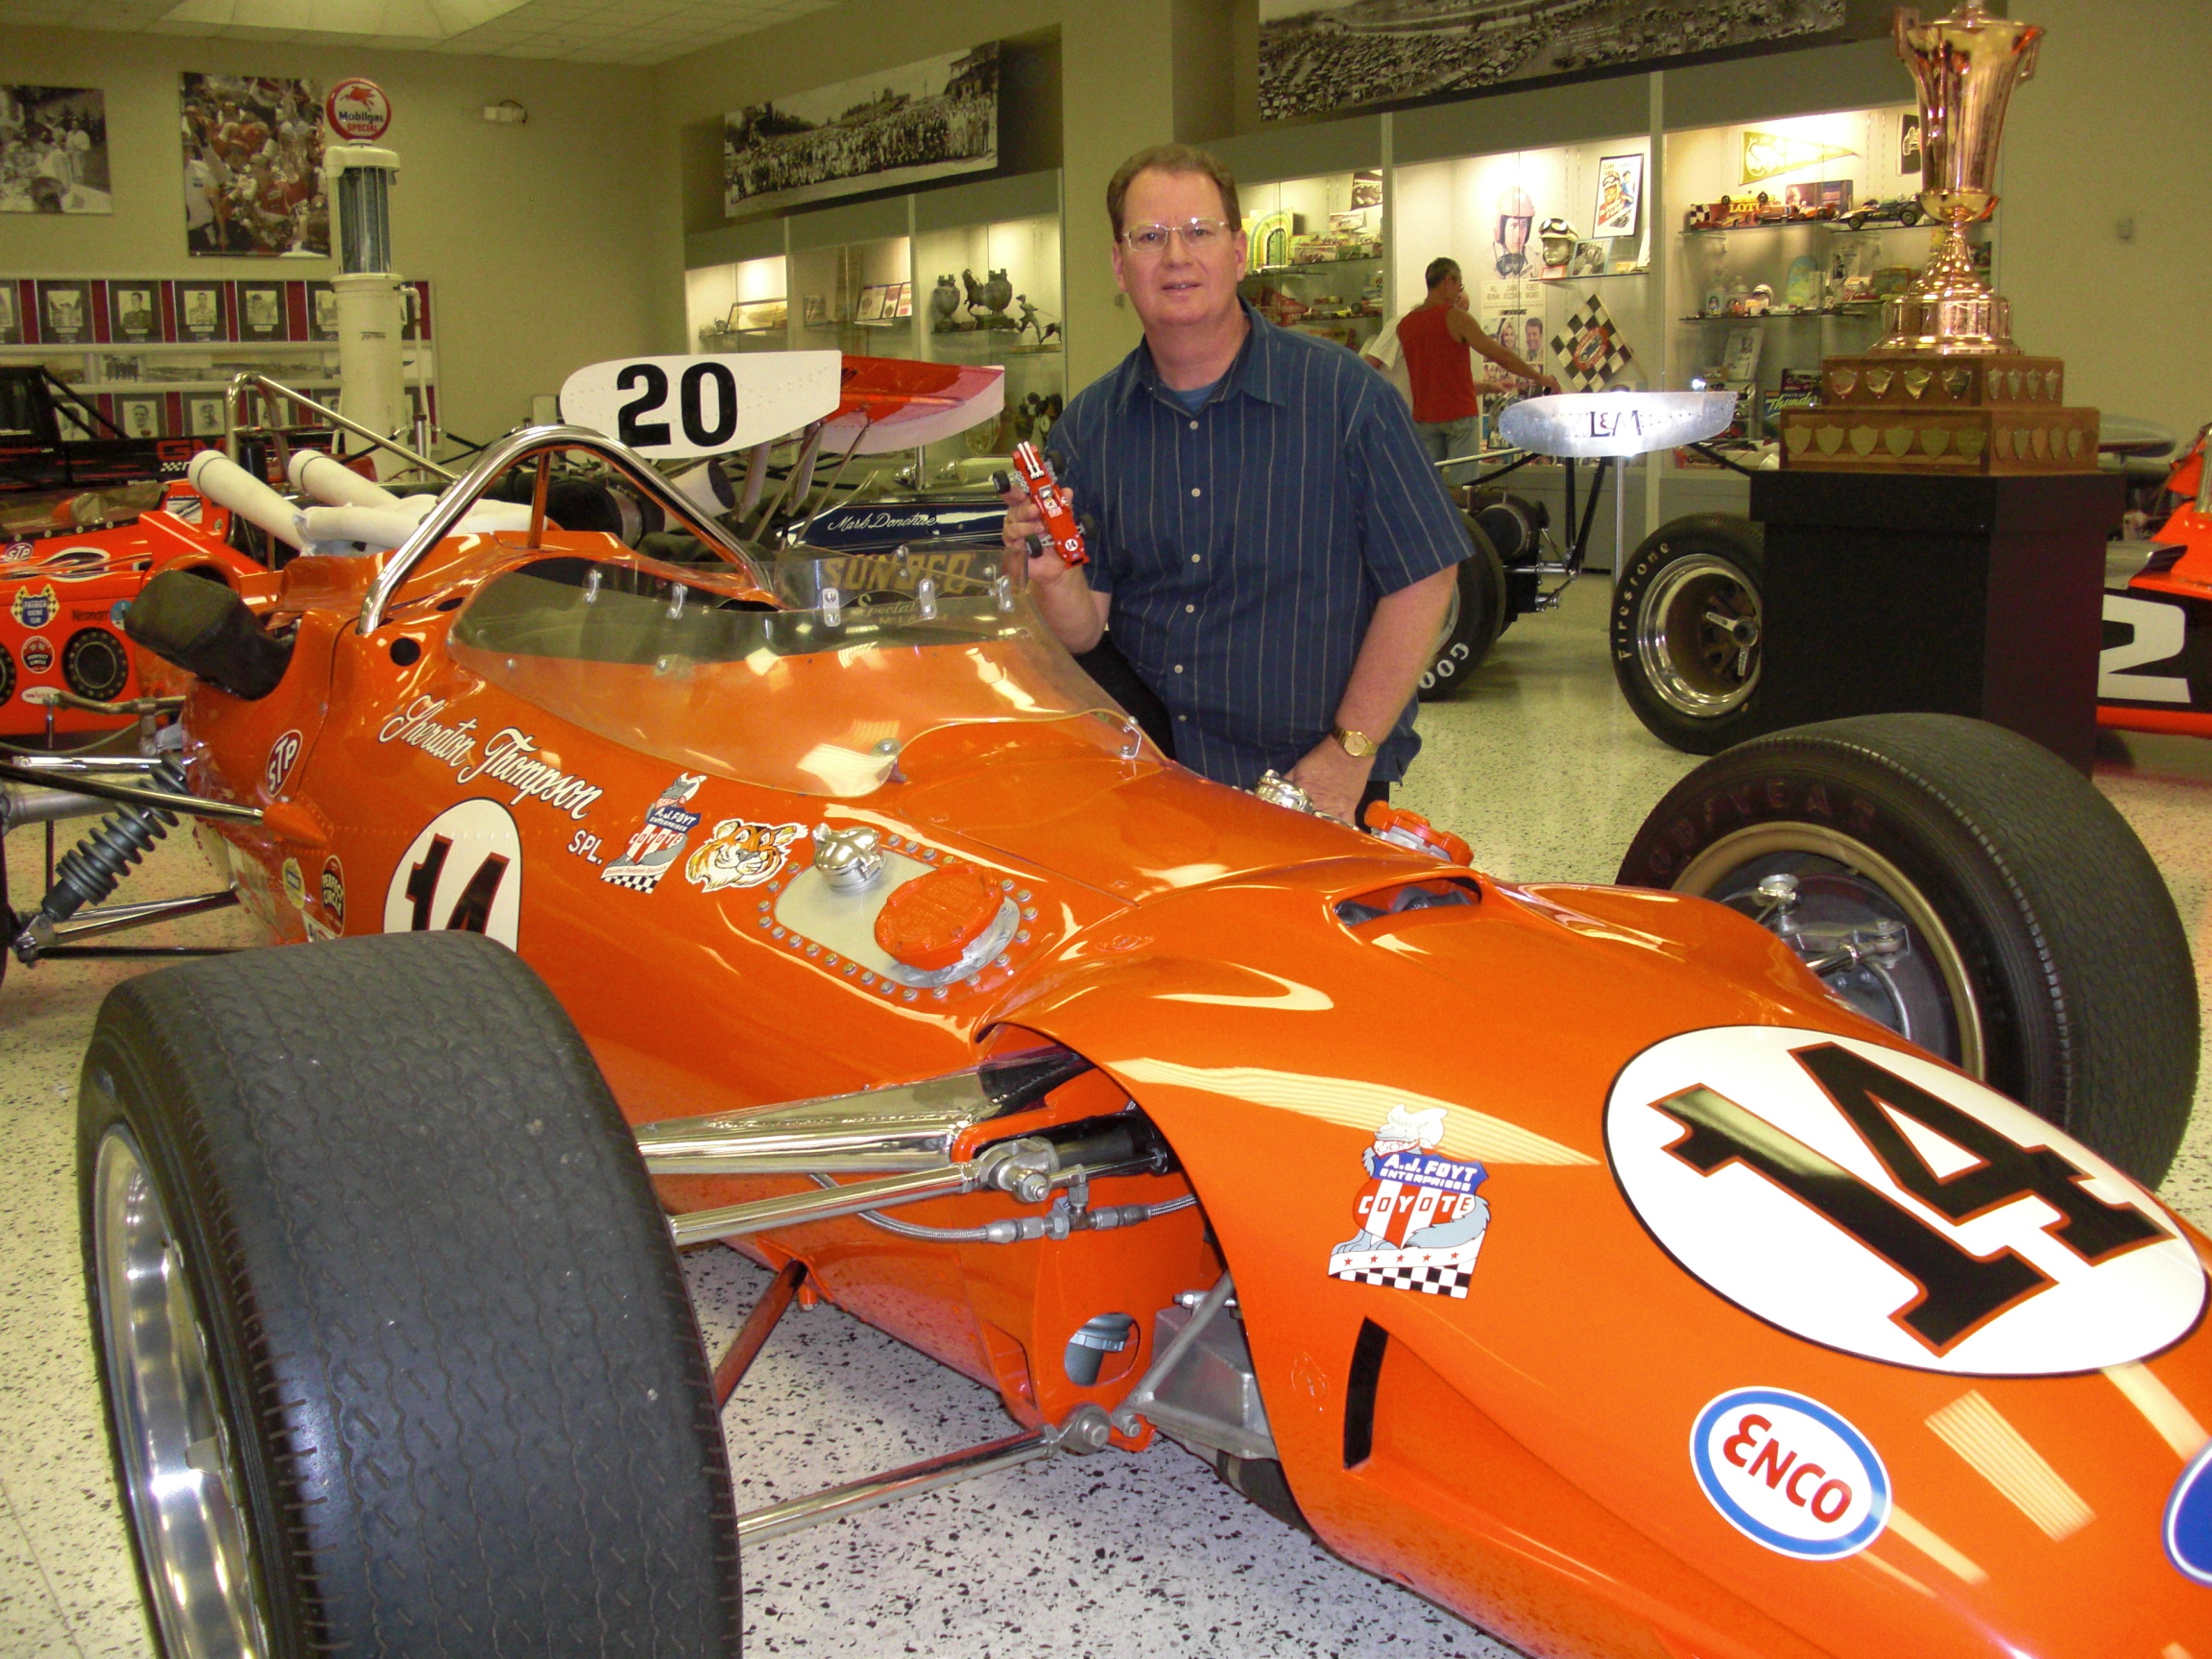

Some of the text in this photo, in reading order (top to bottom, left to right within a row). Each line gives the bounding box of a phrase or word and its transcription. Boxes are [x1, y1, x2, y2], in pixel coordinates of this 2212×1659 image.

[339, 111, 383, 124] Mobilgas
[1728, 203, 1763, 213] LOTU
[616, 362, 738, 448] 20
[828, 512, 937, 532] Mark Donohue
[7, 544, 32, 560] STP
[1066, 540, 1077, 550] 14
[824, 553, 974, 594] SUNOCO
[1617, 541, 1671, 661] Firestone
[269, 736, 298, 792] STP
[379, 694, 604, 820] Sheraton Thompson
[649, 816, 688, 832] ENTERPRISES
[629, 832, 685, 845] COYOTE
[405, 833, 510, 935] 14
[1380, 1168, 1472, 1191] ENTERPRISES
[1424, 1160, 1479, 1182] FOYT
[1358, 1196, 1472, 1214] COYOTE
[1647, 1041, 2177, 1358] 14
[1723, 1413, 1853, 1524] ENCO
